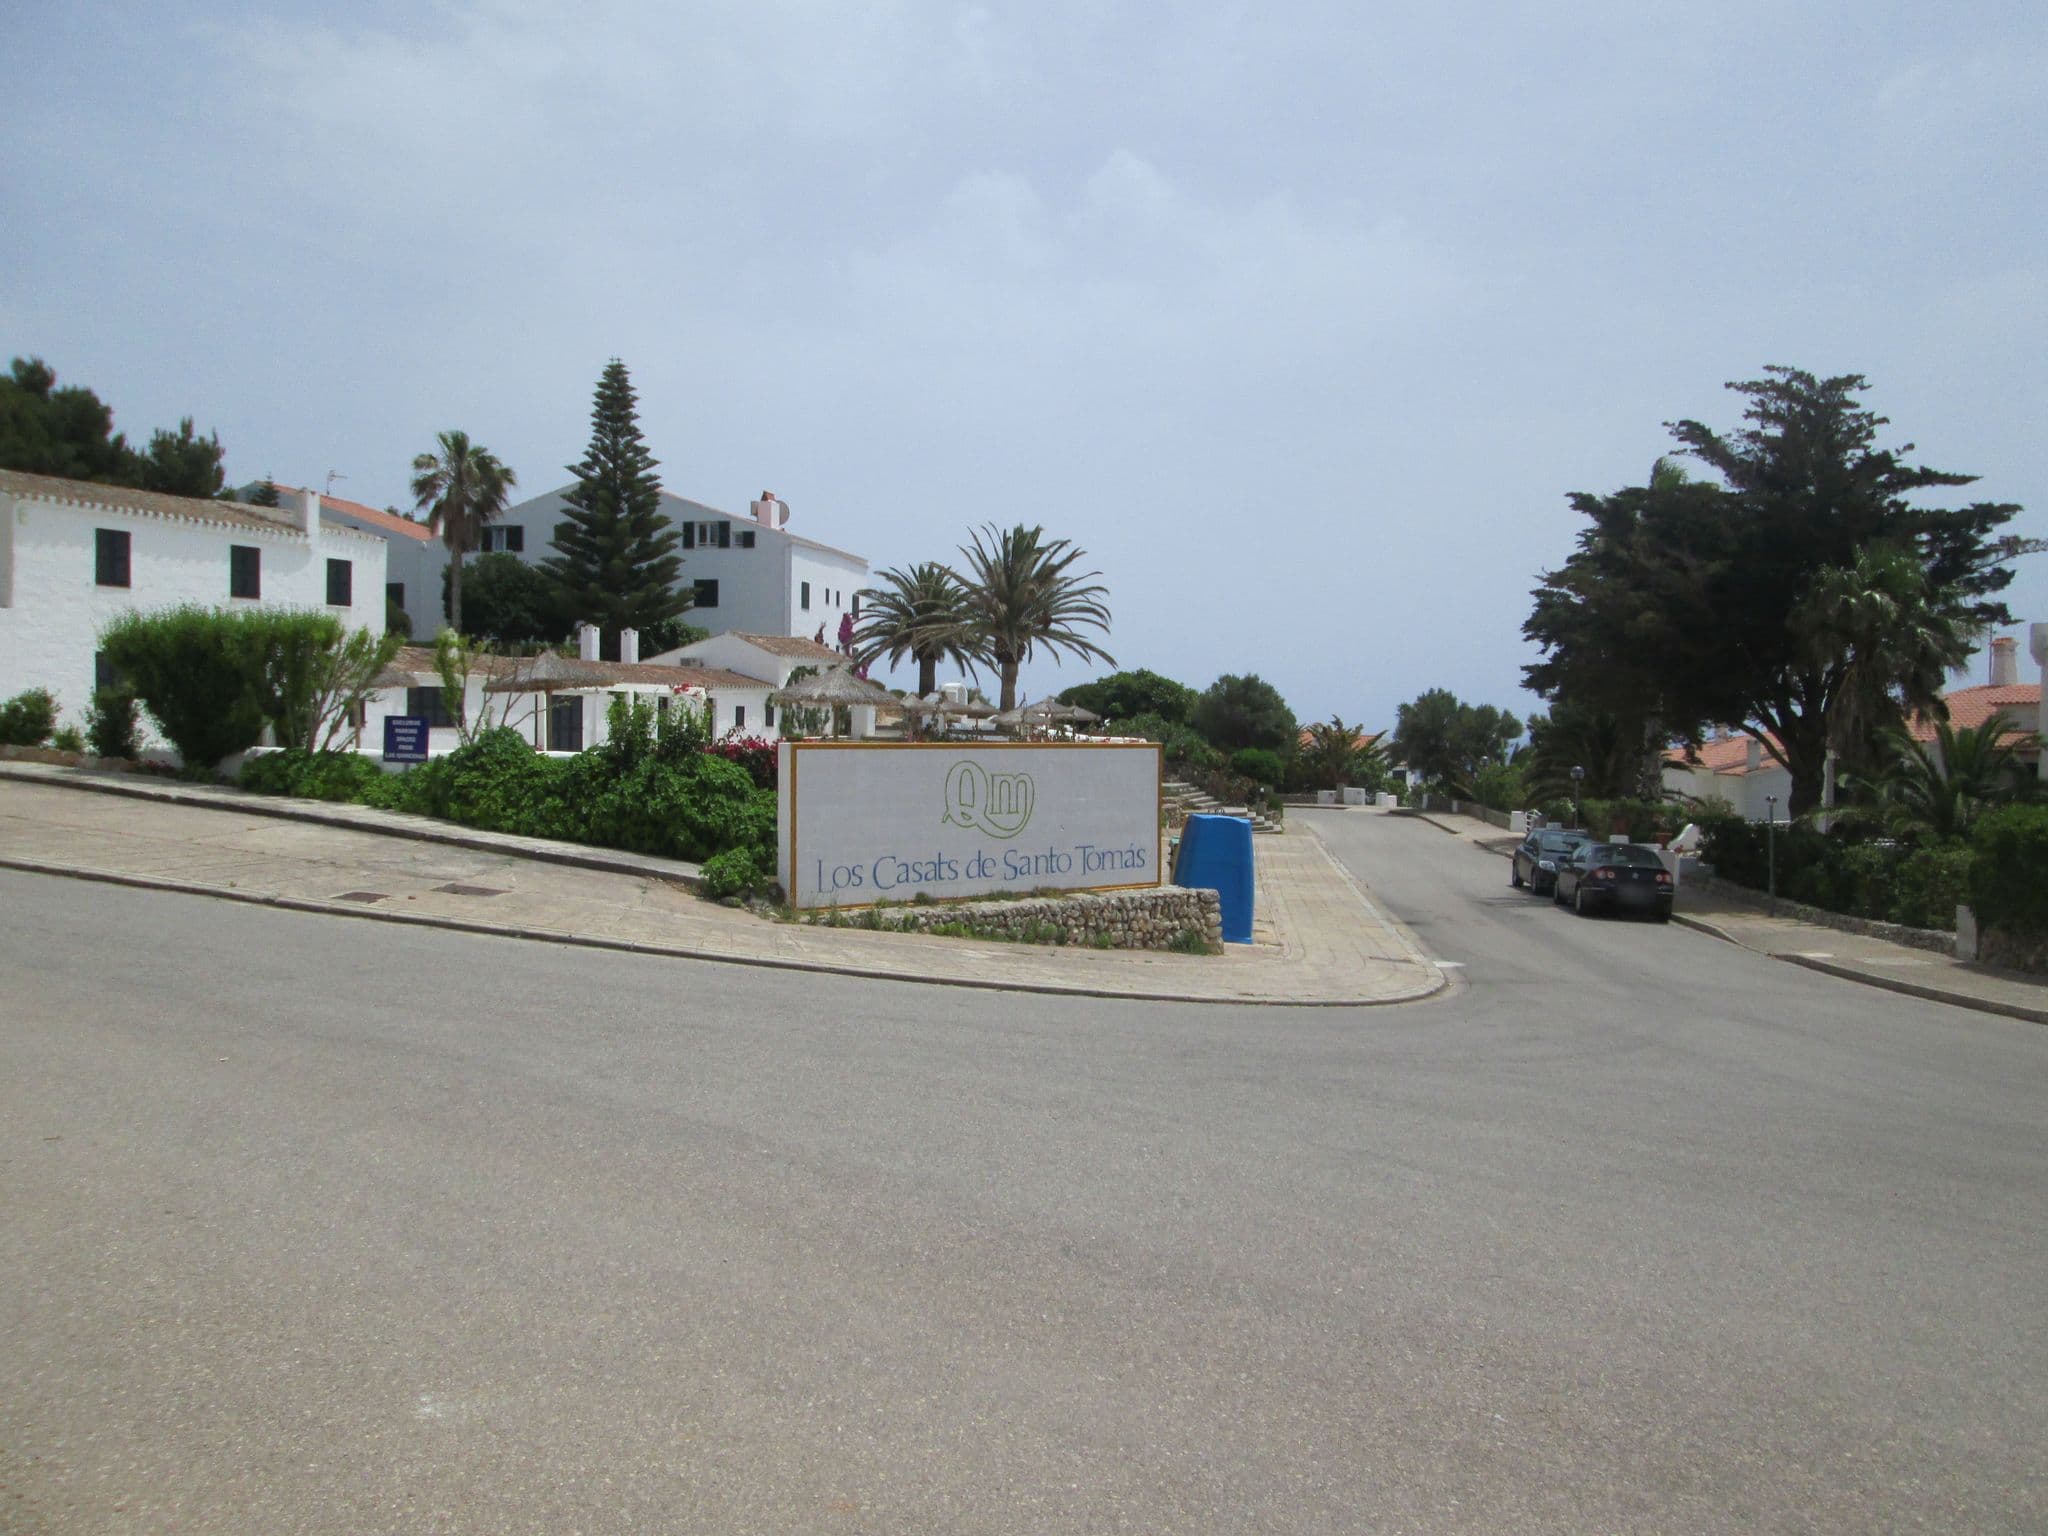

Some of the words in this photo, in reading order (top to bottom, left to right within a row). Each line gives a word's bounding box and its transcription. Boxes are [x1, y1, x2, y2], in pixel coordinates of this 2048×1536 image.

[816, 858, 864, 894] Los
[872, 851, 959, 891] Casats
[965, 849, 997, 880] de
[1003, 845, 1073, 881] Santo
[1075, 842, 1146, 876] Tomás
